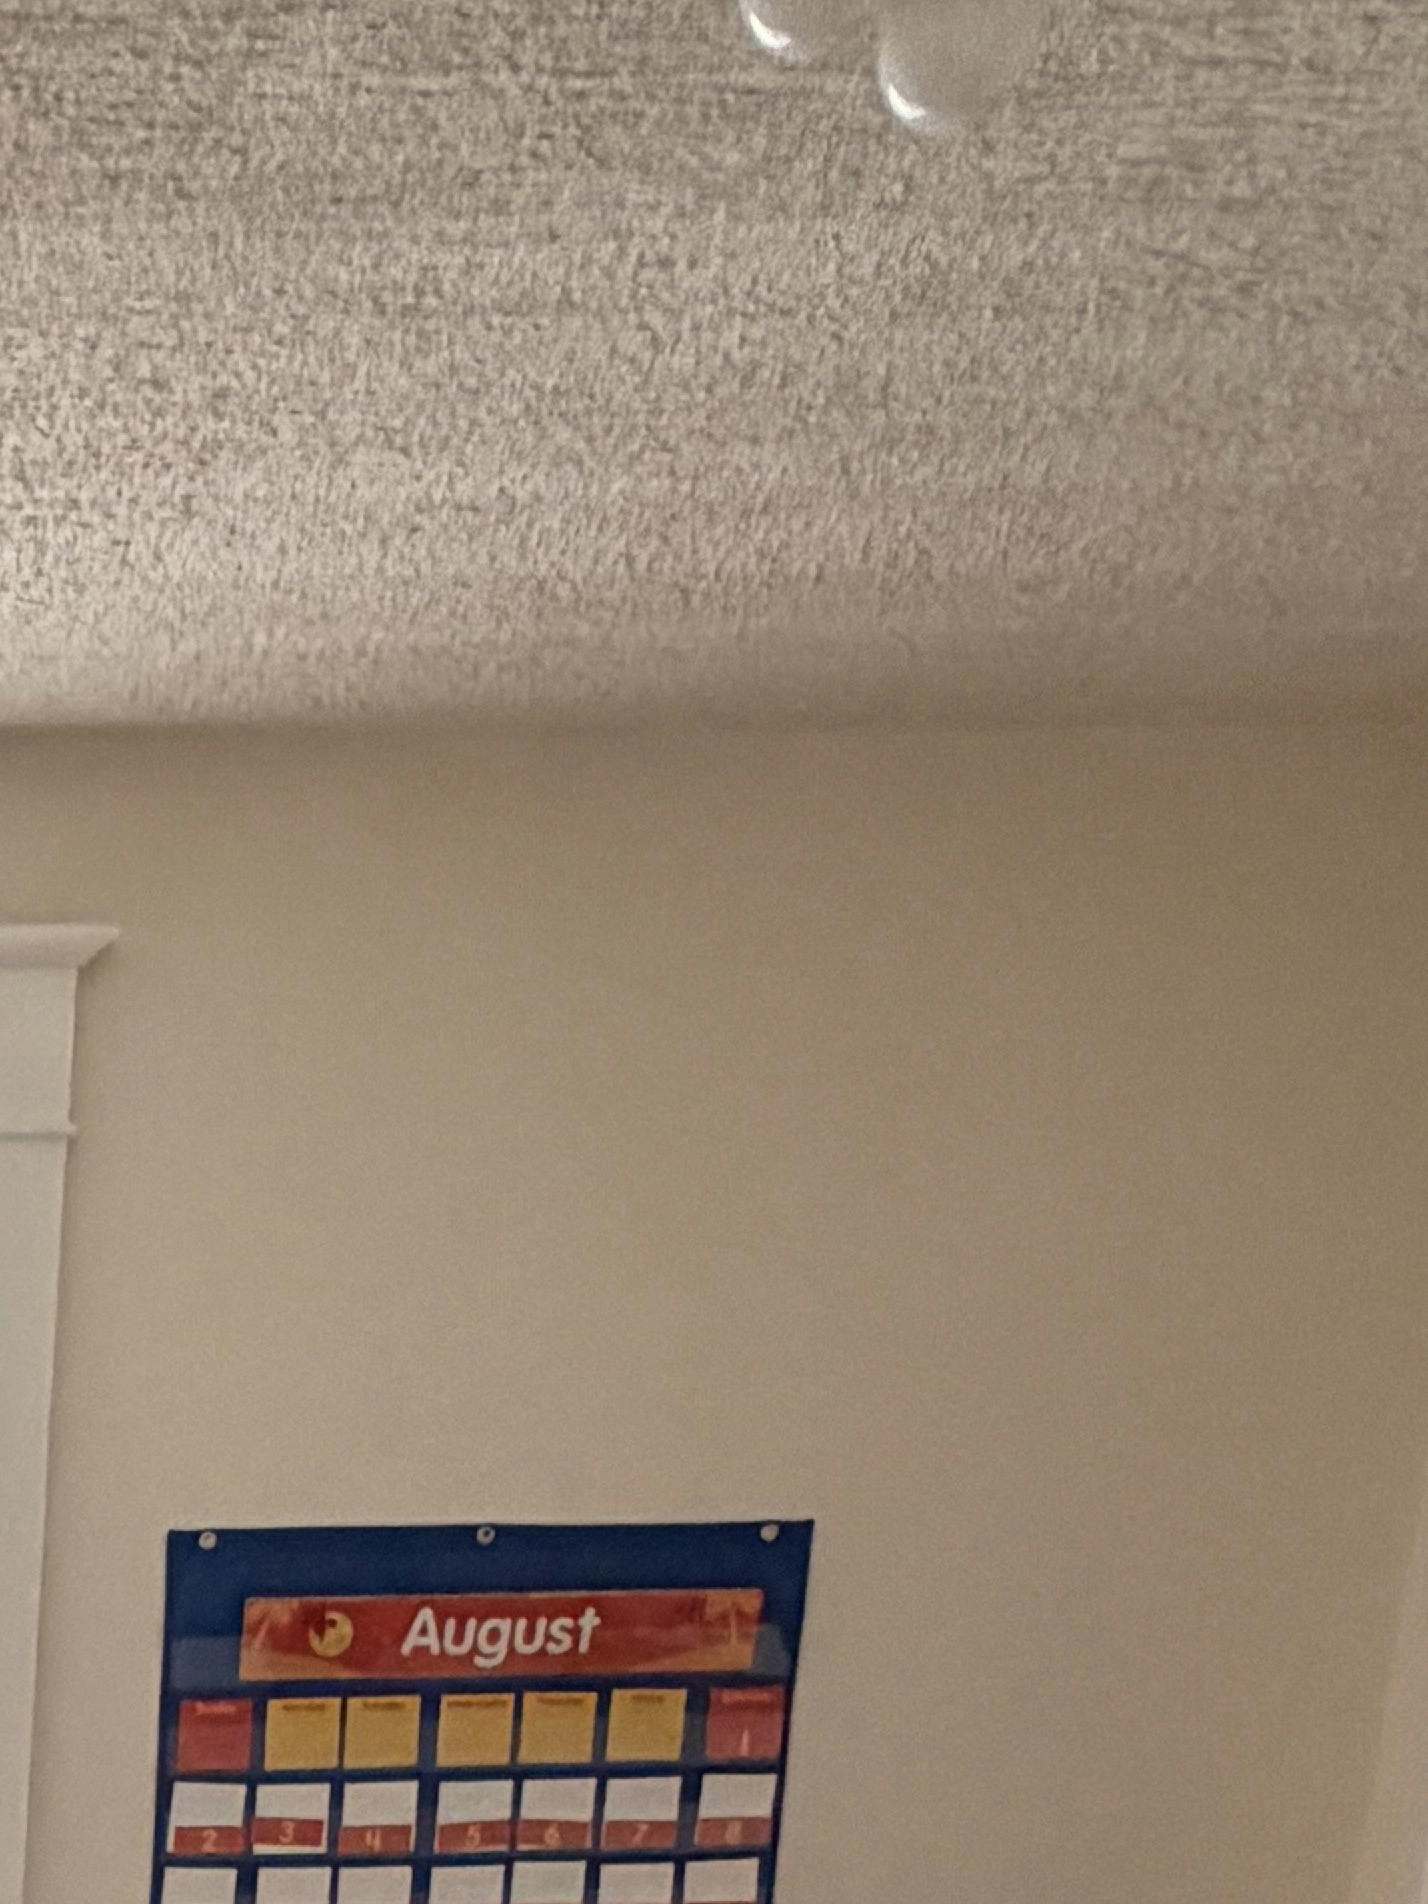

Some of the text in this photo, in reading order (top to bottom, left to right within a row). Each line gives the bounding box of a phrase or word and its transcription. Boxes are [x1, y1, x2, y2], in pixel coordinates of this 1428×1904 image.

[400, 1605, 603, 1668] August
[201, 1829, 217, 1848] 2
[278, 1821, 294, 1842] 3
[364, 1830, 382, 1849] 4
[466, 1825, 482, 1847] 5
[546, 1823, 560, 1845] 6
[630, 1823, 649, 1844] 7
